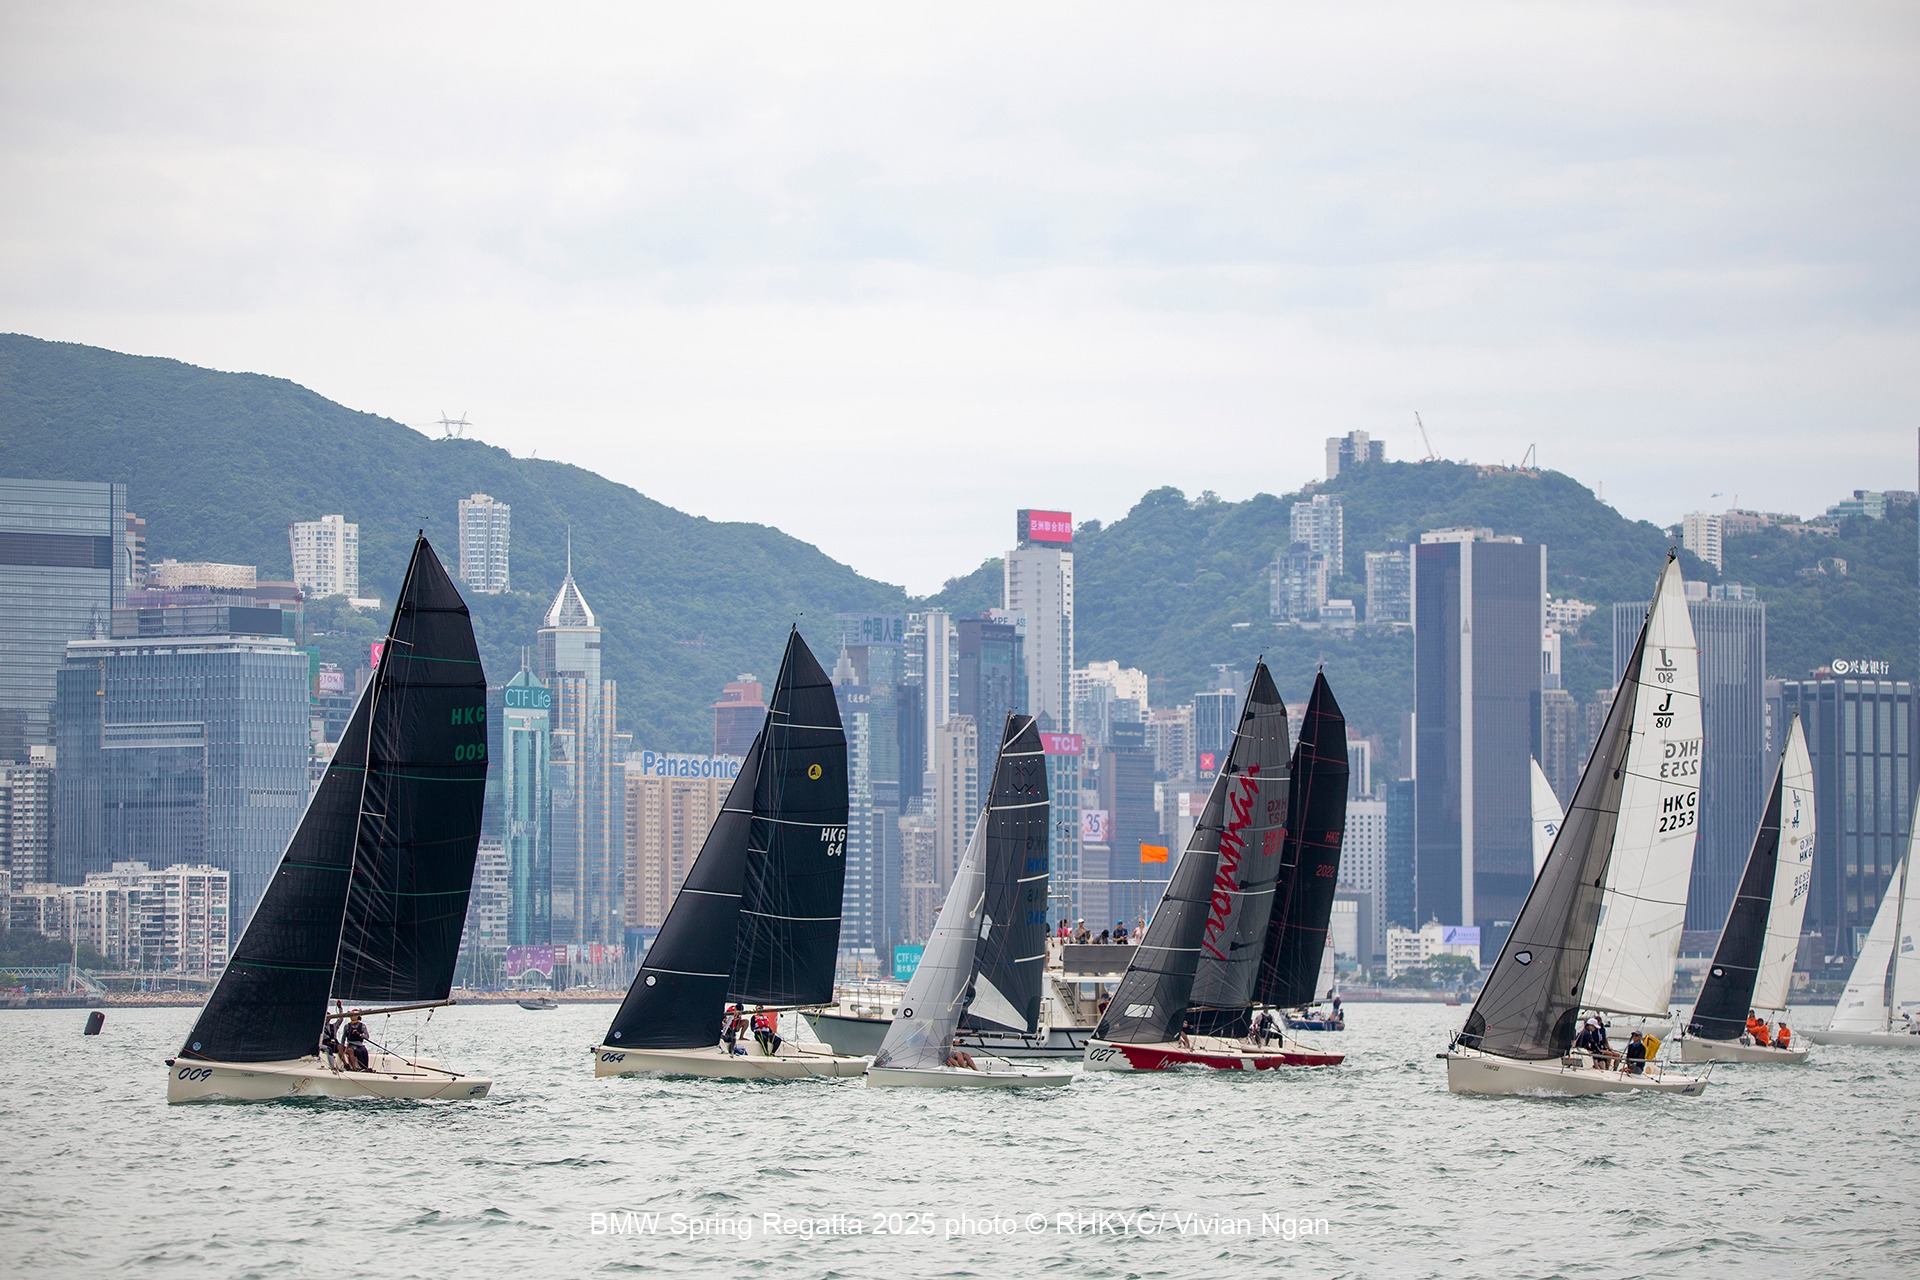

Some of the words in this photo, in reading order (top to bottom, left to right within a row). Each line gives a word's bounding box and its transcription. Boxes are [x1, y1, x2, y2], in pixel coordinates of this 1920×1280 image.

[1849, 659, 1889, 674] 兴业银行
[505, 689, 529, 706] CTF
[531, 690, 551, 708] Life
[1658, 693, 1673, 711] J
[451, 706, 485, 725] HKG
[1655, 717, 1672, 729] 80
[1051, 736, 1079, 751] TCL
[455, 743, 486, 761] 009
[642, 750, 740, 779] Panasonic
[1200, 771, 1215, 779] DBS
[1662, 791, 1696, 813] HKG
[1086, 813, 1100, 833] 35
[1658, 811, 1695, 833] 2253
[821, 828, 846, 841] HKG
[1325, 831, 1340, 844] HKG
[827, 843, 842, 856] 64
[1799, 848, 1812, 863] HKG
[1026, 857, 1048, 872] HKG
[1316, 865, 1335, 878] 2022
[896, 952, 910, 963] CTF
[601, 1052, 625, 1063] 064
[1089, 1048, 1116, 1063] 027
[178, 1067, 213, 1082] 009
